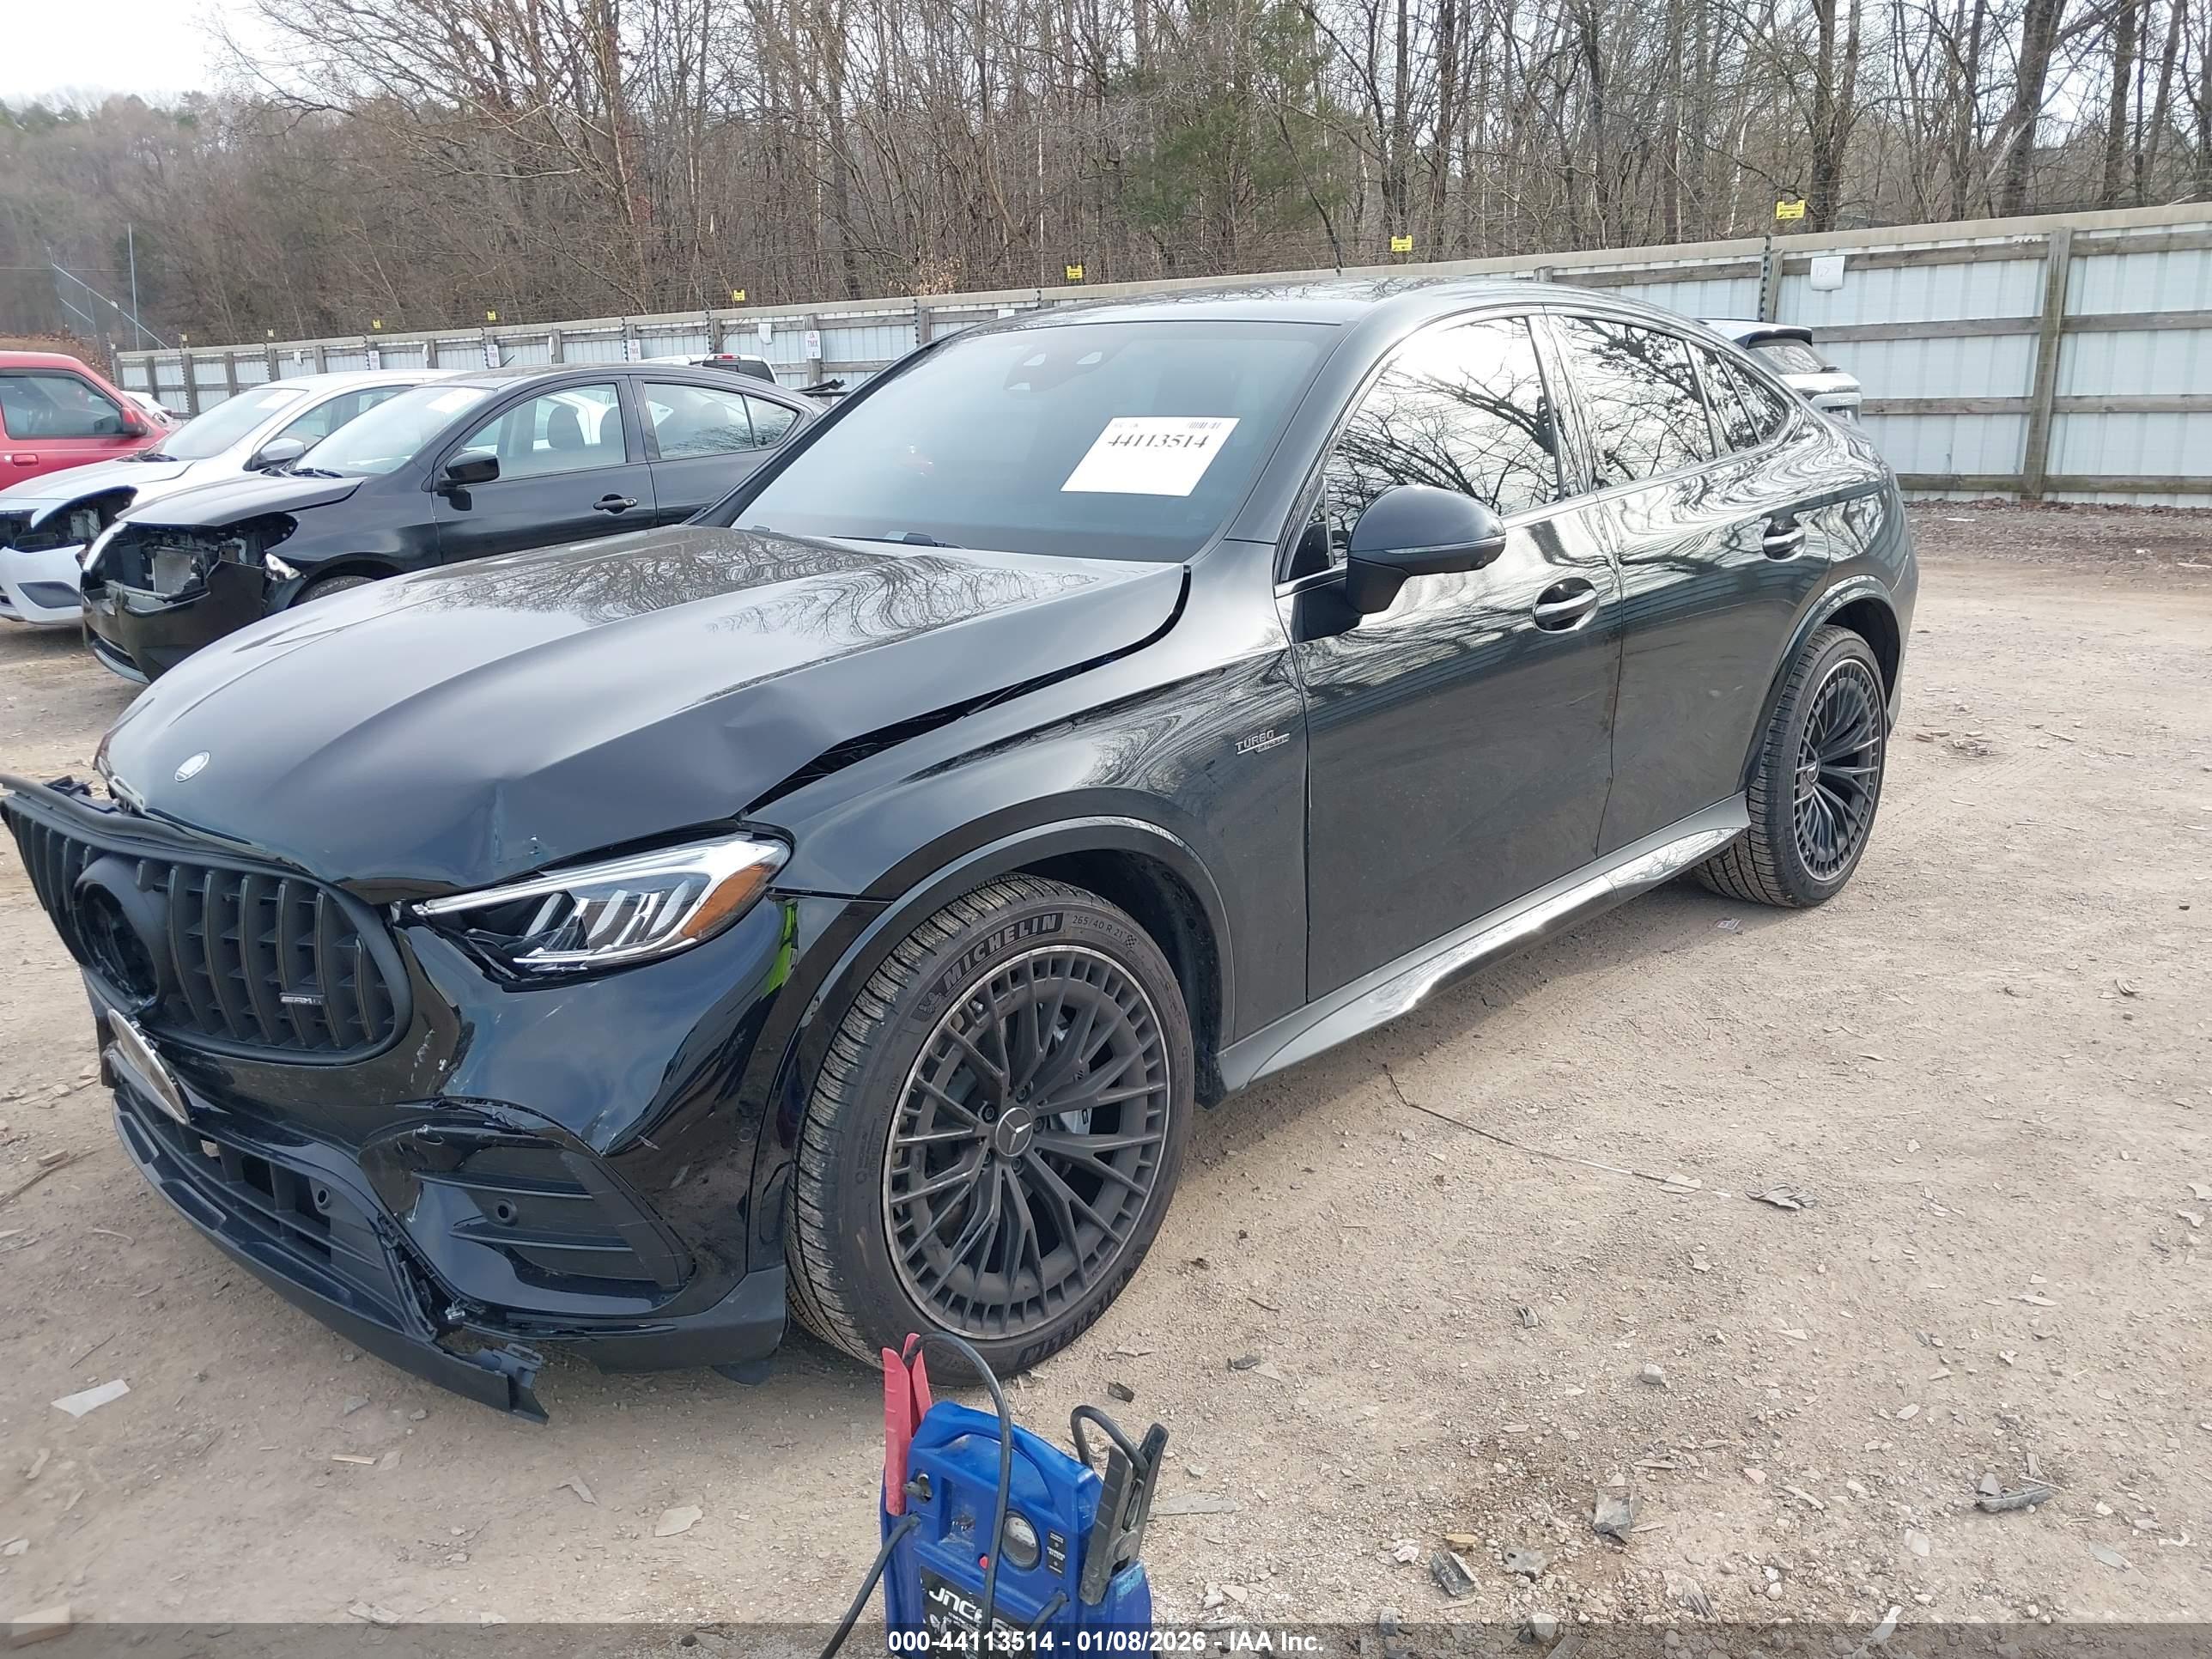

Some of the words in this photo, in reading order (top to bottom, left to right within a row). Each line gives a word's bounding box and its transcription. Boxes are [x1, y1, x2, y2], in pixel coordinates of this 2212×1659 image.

[1108, 434, 1210, 448] 44113514
[1235, 730, 1274, 750] TURBO
[1072, 915, 1105, 929] 265/40
[1105, 925, 1113, 933] R
[1114, 928, 1124, 939] 21
[944, 914, 1057, 990] MICHELIN
